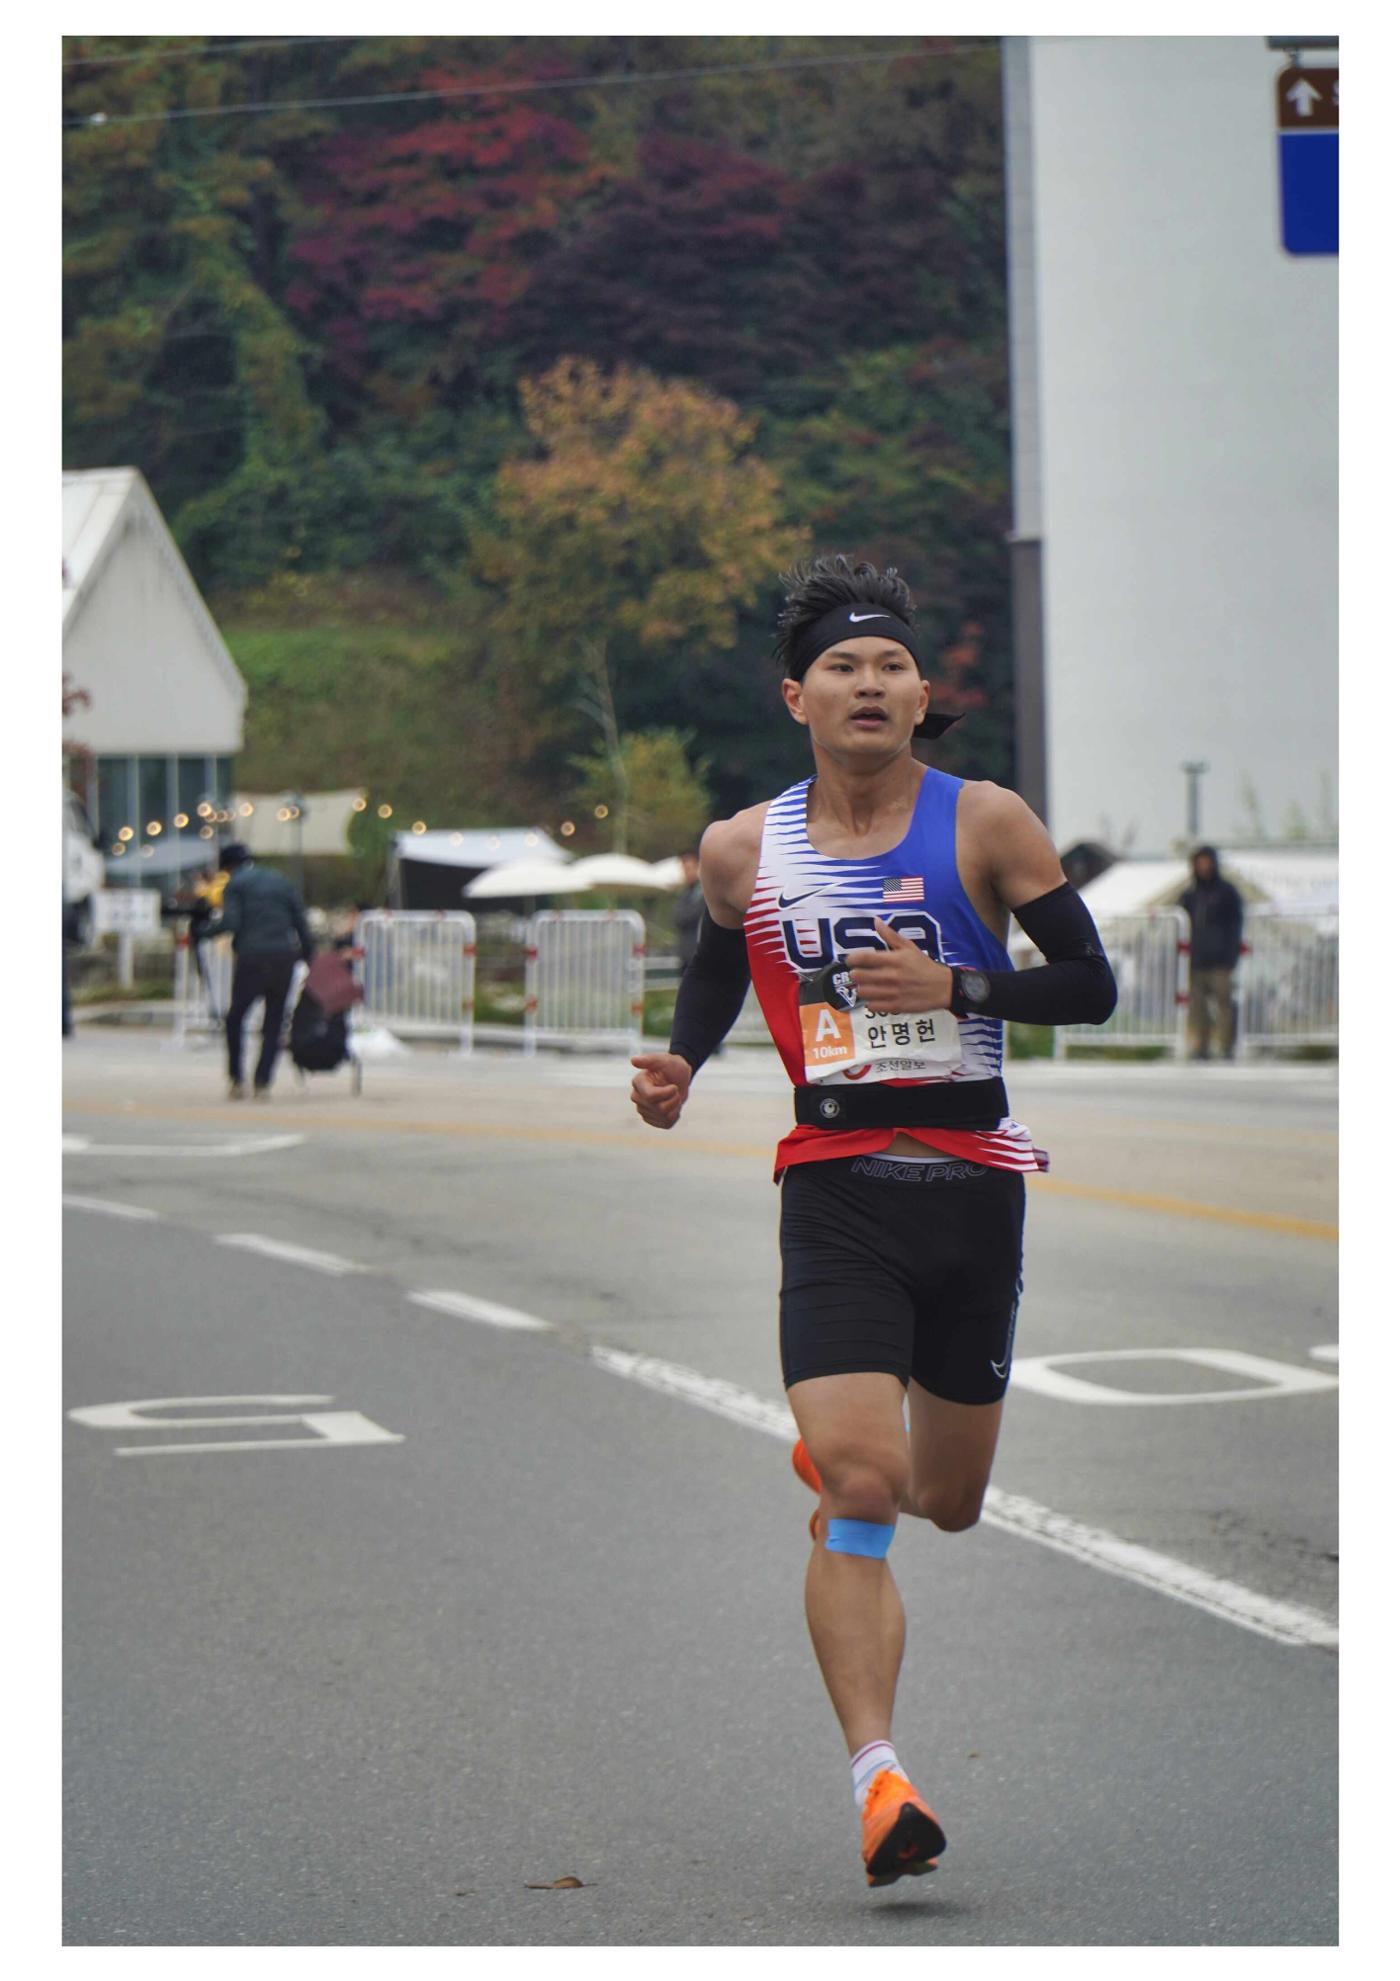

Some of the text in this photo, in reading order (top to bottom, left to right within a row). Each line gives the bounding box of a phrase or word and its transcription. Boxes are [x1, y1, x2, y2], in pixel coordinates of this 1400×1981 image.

[781, 912, 944, 970] USA
[815, 1008, 841, 1042] A
[867, 1018, 936, 1049] 안명헌
[811, 1045, 848, 1060] 10km
[851, 1157, 926, 1182] NIKE
